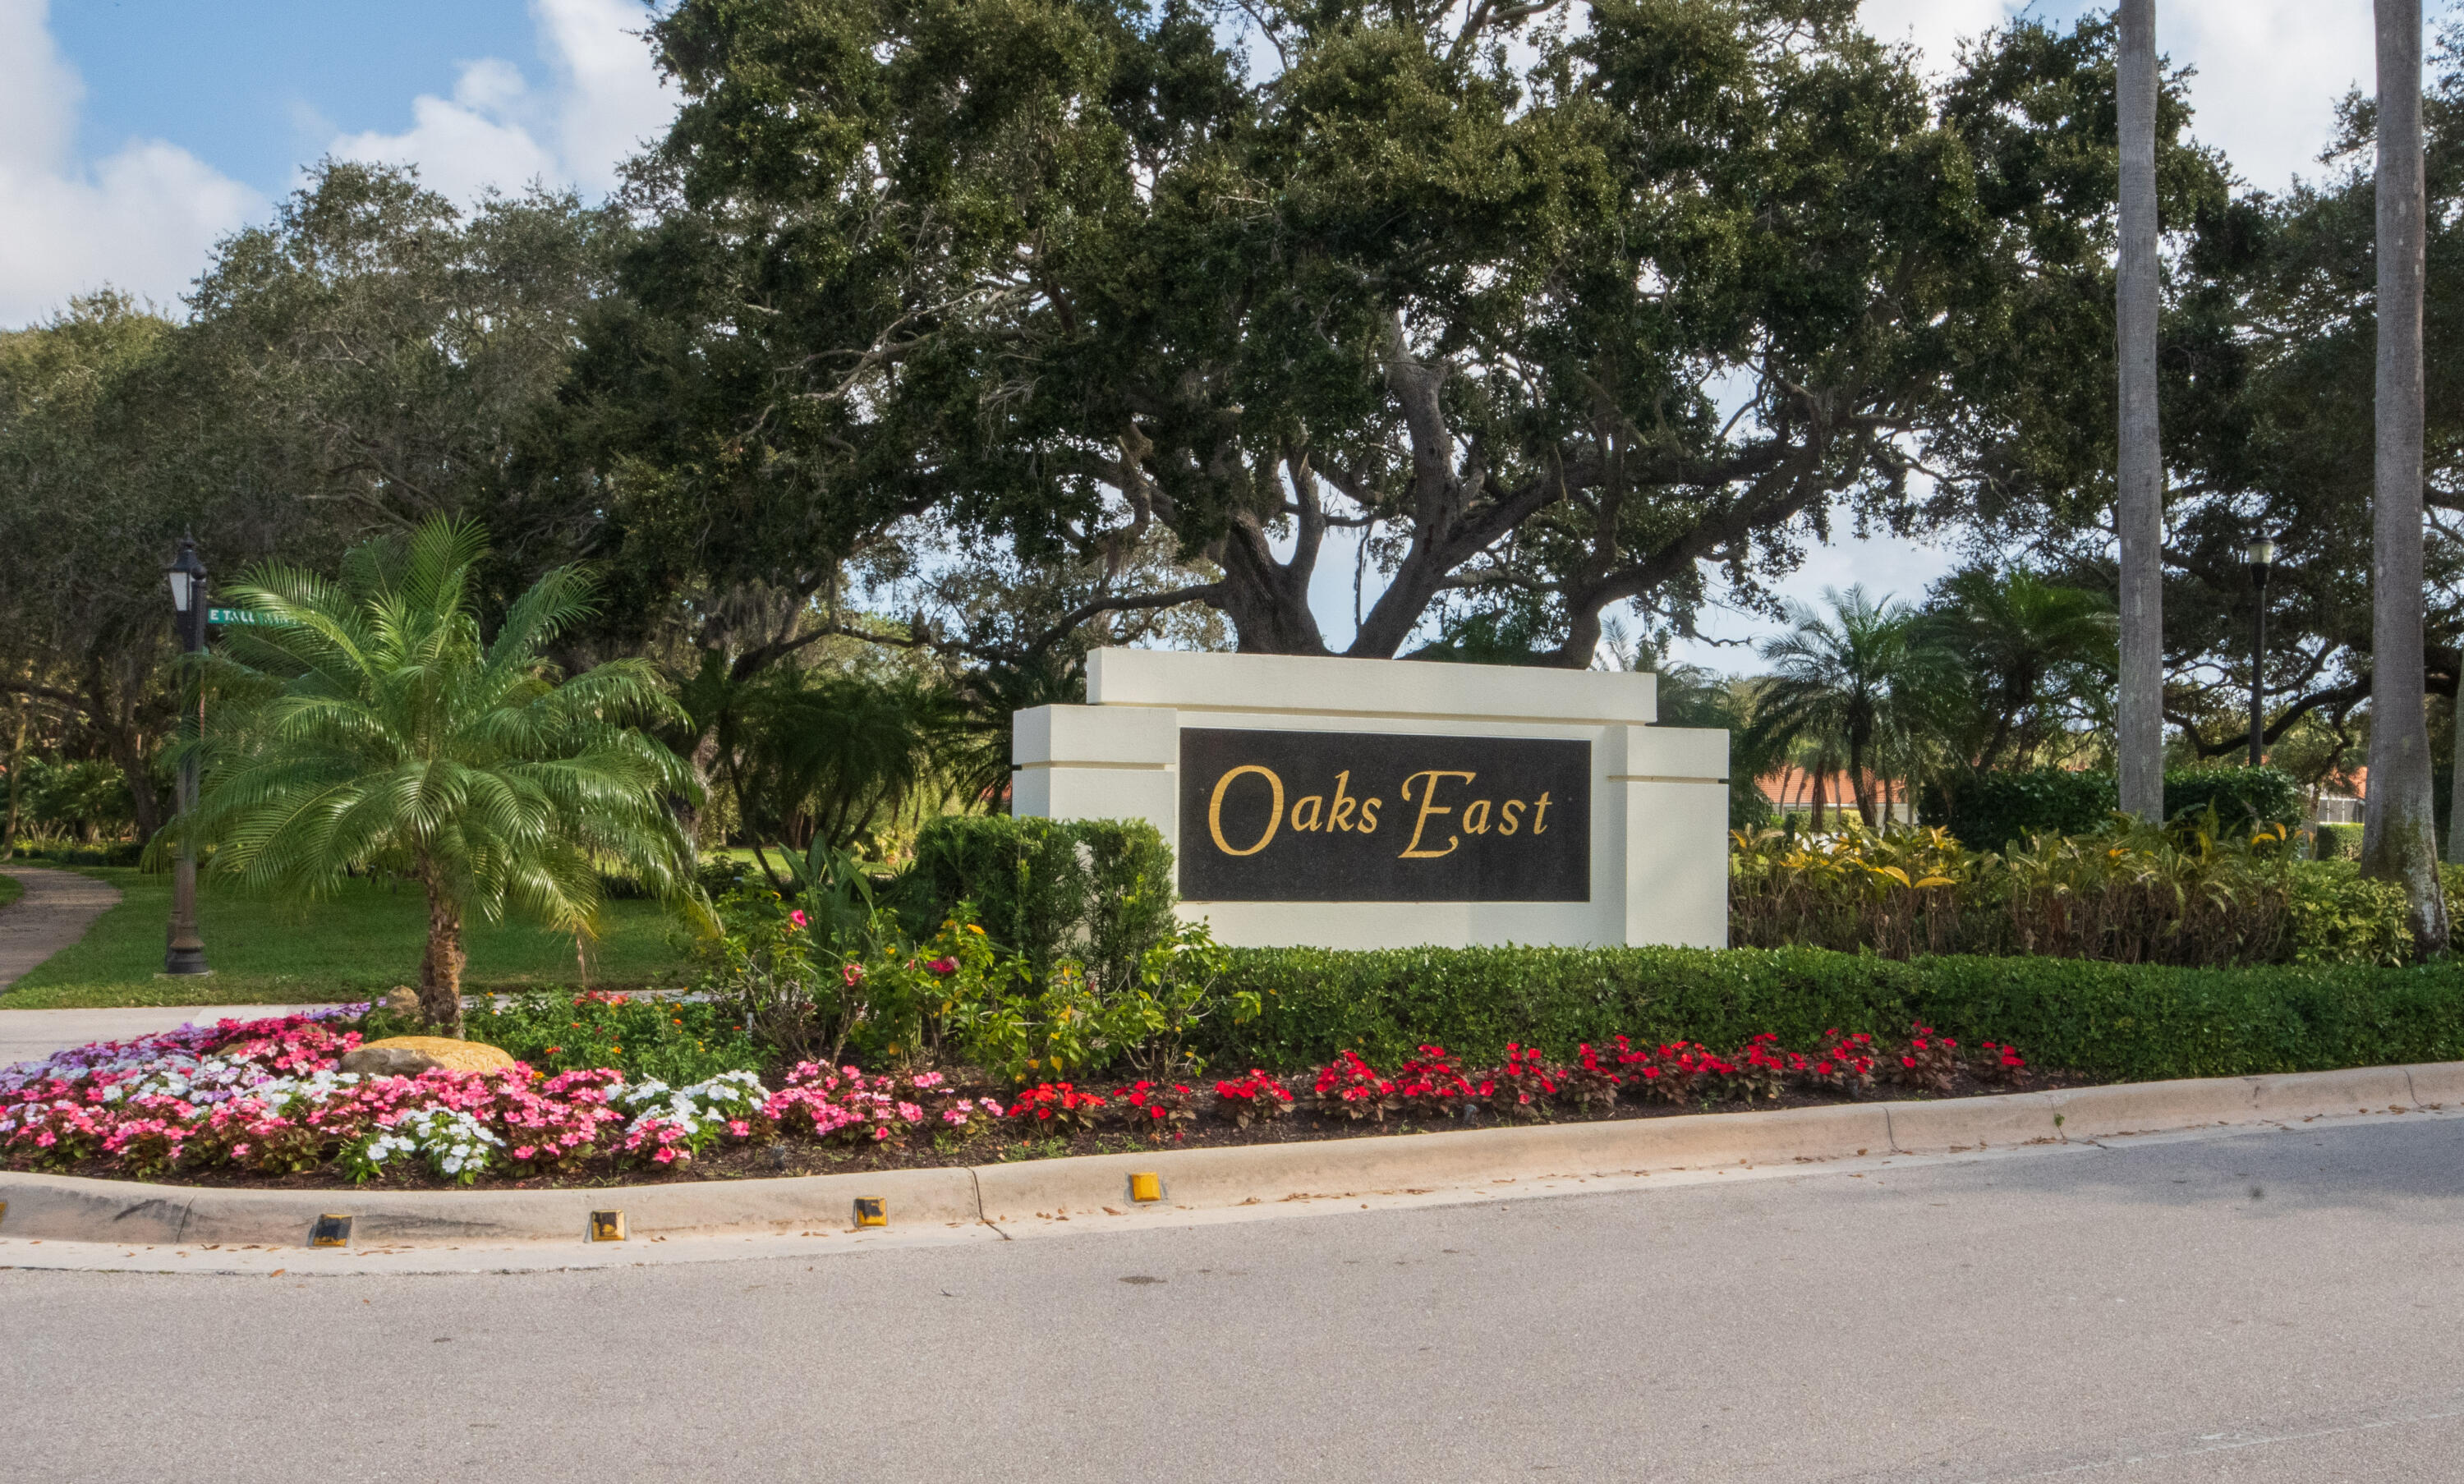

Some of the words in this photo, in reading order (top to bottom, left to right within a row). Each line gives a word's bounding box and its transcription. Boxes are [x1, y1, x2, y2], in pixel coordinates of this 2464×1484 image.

[210, 609, 218, 620] E
[1208, 765, 1382, 857] Oaks
[1399, 770, 1553, 858] East
